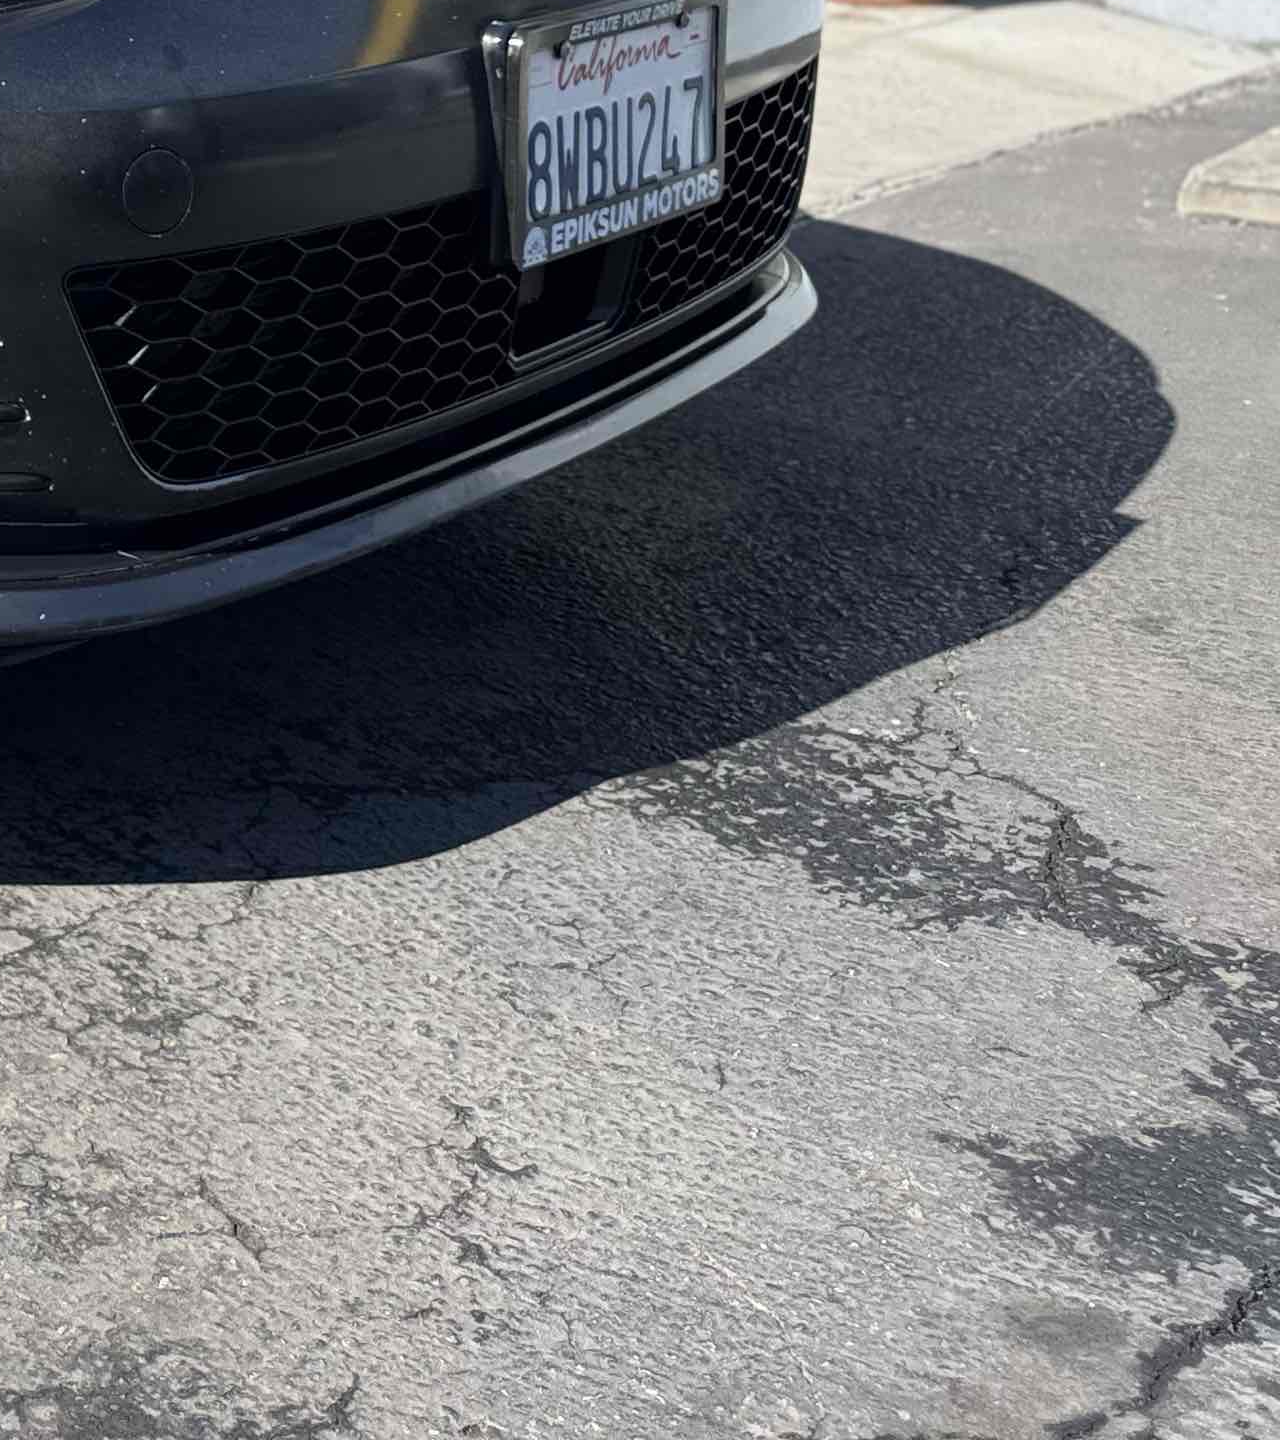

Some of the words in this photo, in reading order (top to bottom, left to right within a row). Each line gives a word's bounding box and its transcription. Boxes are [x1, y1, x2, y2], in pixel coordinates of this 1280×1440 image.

[557, 34, 682, 96] California
[527, 75, 704, 222] 8WBU247
[551, 197, 639, 253] EPIKSUN
[642, 168, 721, 222] MOTORS
